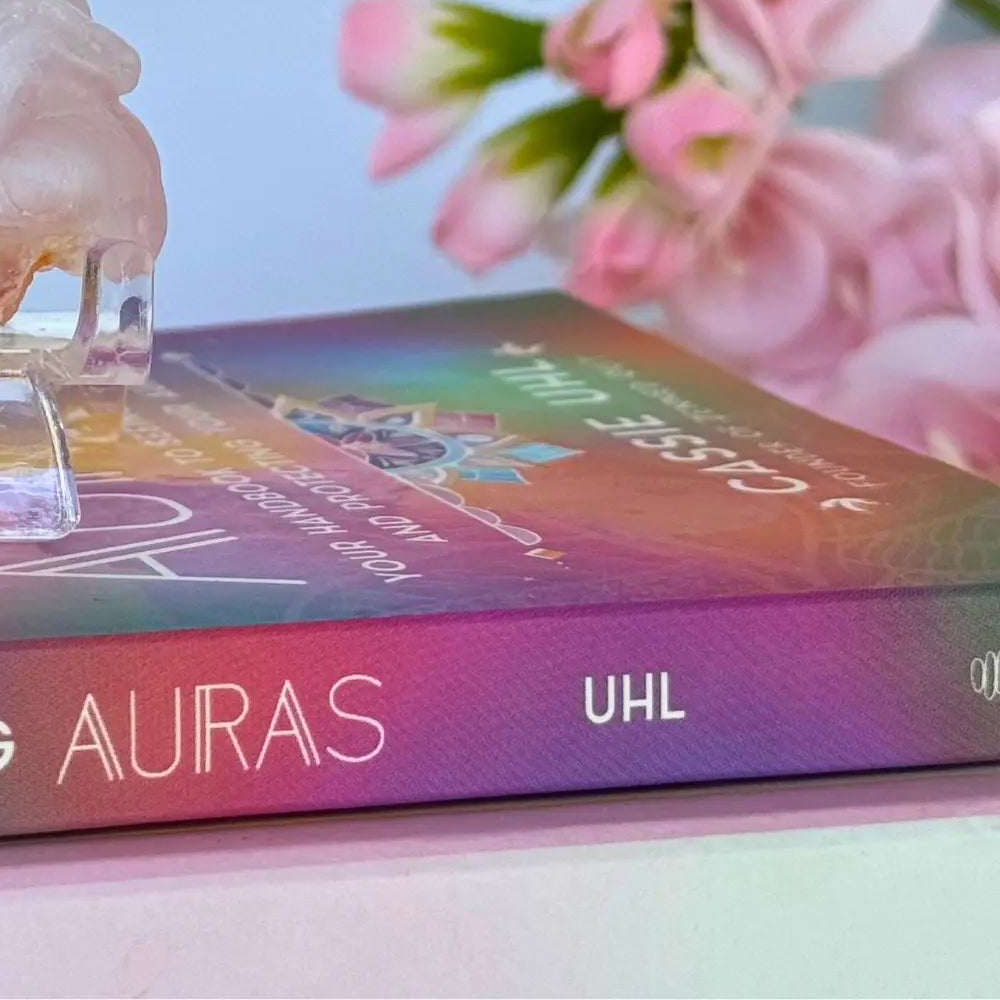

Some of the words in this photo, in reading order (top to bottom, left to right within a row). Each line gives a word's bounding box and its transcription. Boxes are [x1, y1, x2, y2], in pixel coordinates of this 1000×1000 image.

[491, 358, 612, 406] UHL
[164, 448, 215, 464] TO
[223, 438, 385, 511] PROTECTING
[584, 412, 809, 494] CASSIE
[198, 466, 348, 535] HANDBOOK
[368, 515, 448, 543] AND
[329, 540, 422, 583] YOUR
[56, 674, 386, 785] AURAS
[584, 671, 686, 725] UHL
